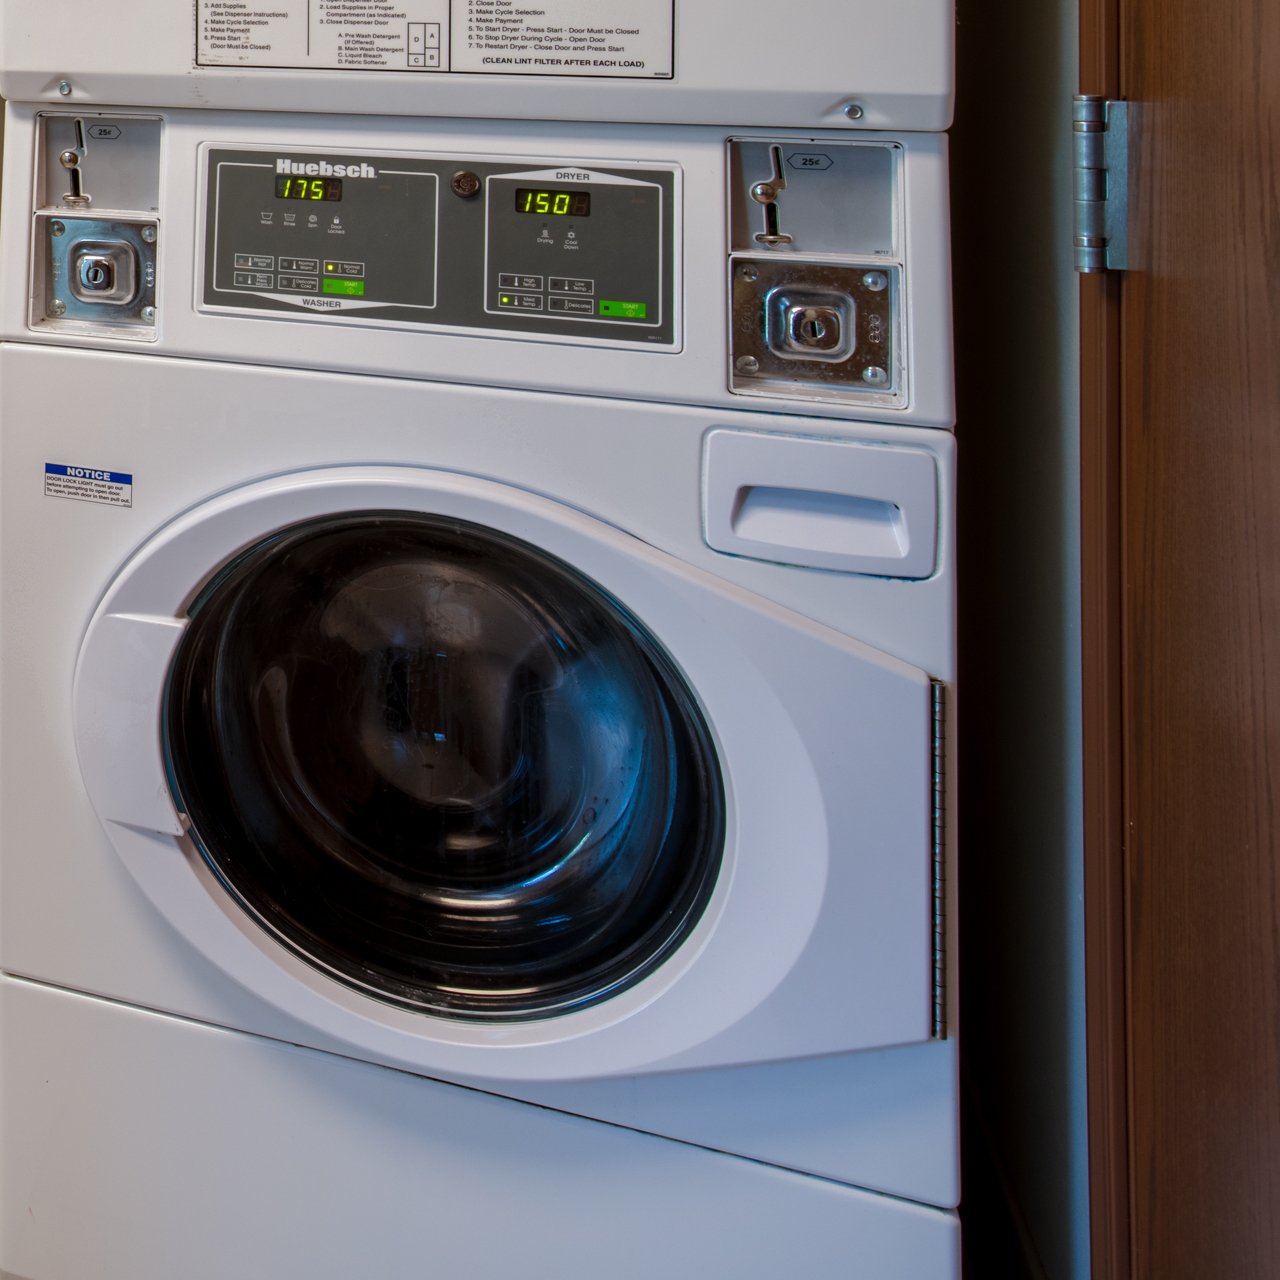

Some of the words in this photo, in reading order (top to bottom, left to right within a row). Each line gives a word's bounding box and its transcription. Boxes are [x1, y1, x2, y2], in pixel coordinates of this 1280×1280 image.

[482, 57, 513, 65] (CLEAN
[618, 60, 645, 68] LOAD)
[276, 159, 375, 178] Huebsch
[556, 172, 590, 181] DRYER
[282, 179, 323, 200] 175
[524, 193, 570, 214] 150
[302, 298, 342, 308] WASHER
[67, 467, 111, 481] NOTICE
